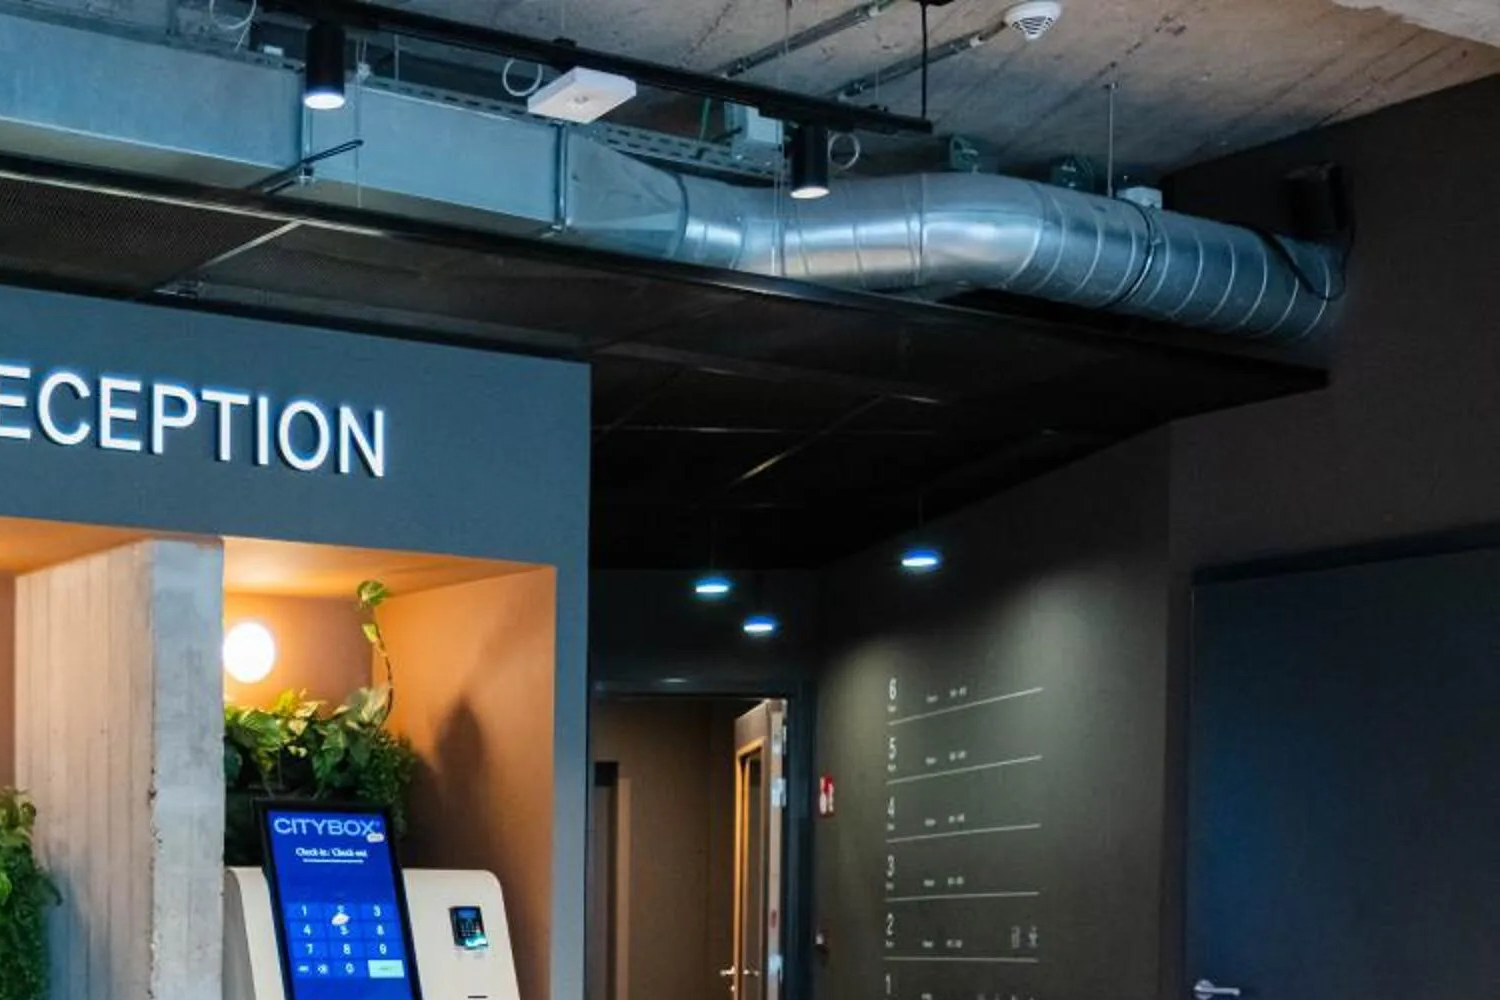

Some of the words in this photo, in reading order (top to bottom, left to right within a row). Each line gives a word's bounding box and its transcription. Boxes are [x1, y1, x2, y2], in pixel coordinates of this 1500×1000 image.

[888, 678, 897, 700] 6
[888, 737, 896, 760] 5
[888, 797, 895, 817] 4
[274, 818, 375, 837] CITYBOX
[887, 855, 895, 877] 3
[887, 913, 895, 936] 2
[885, 973, 892, 995] 1
